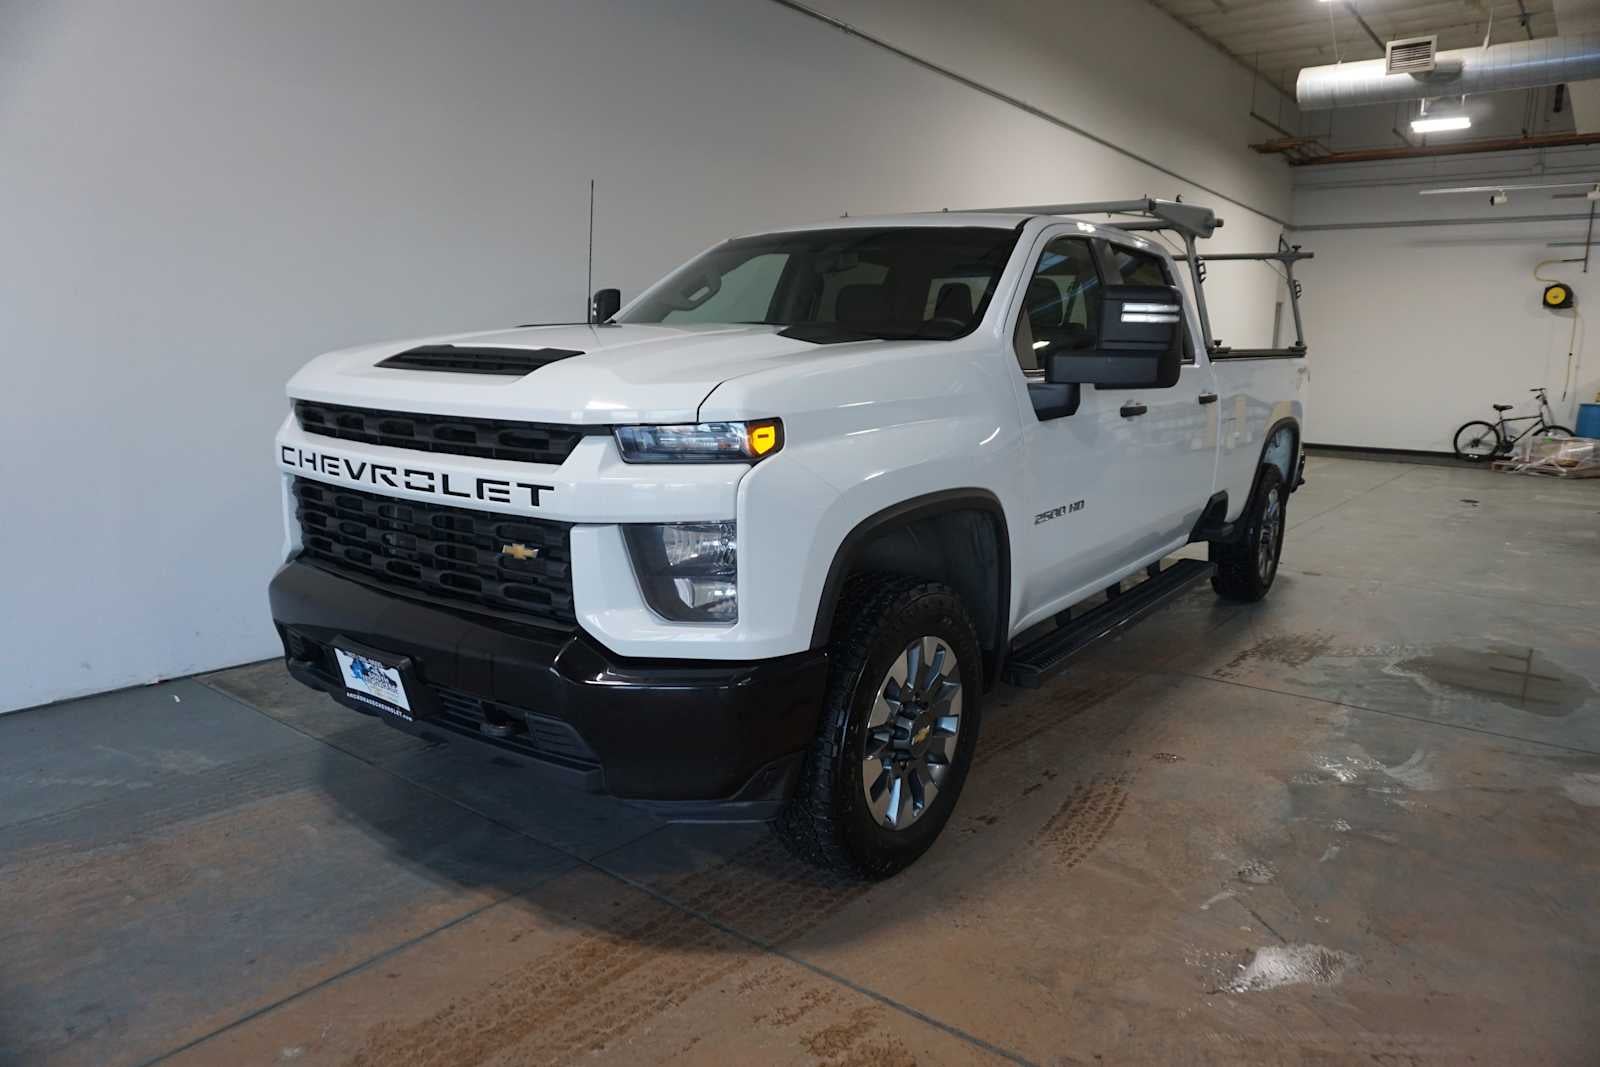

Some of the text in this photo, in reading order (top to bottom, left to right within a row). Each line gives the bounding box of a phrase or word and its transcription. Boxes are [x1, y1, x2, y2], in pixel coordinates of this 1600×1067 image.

[281, 445, 555, 507] CHEVROLET
[1034, 499, 1085, 525] 2500 HD
